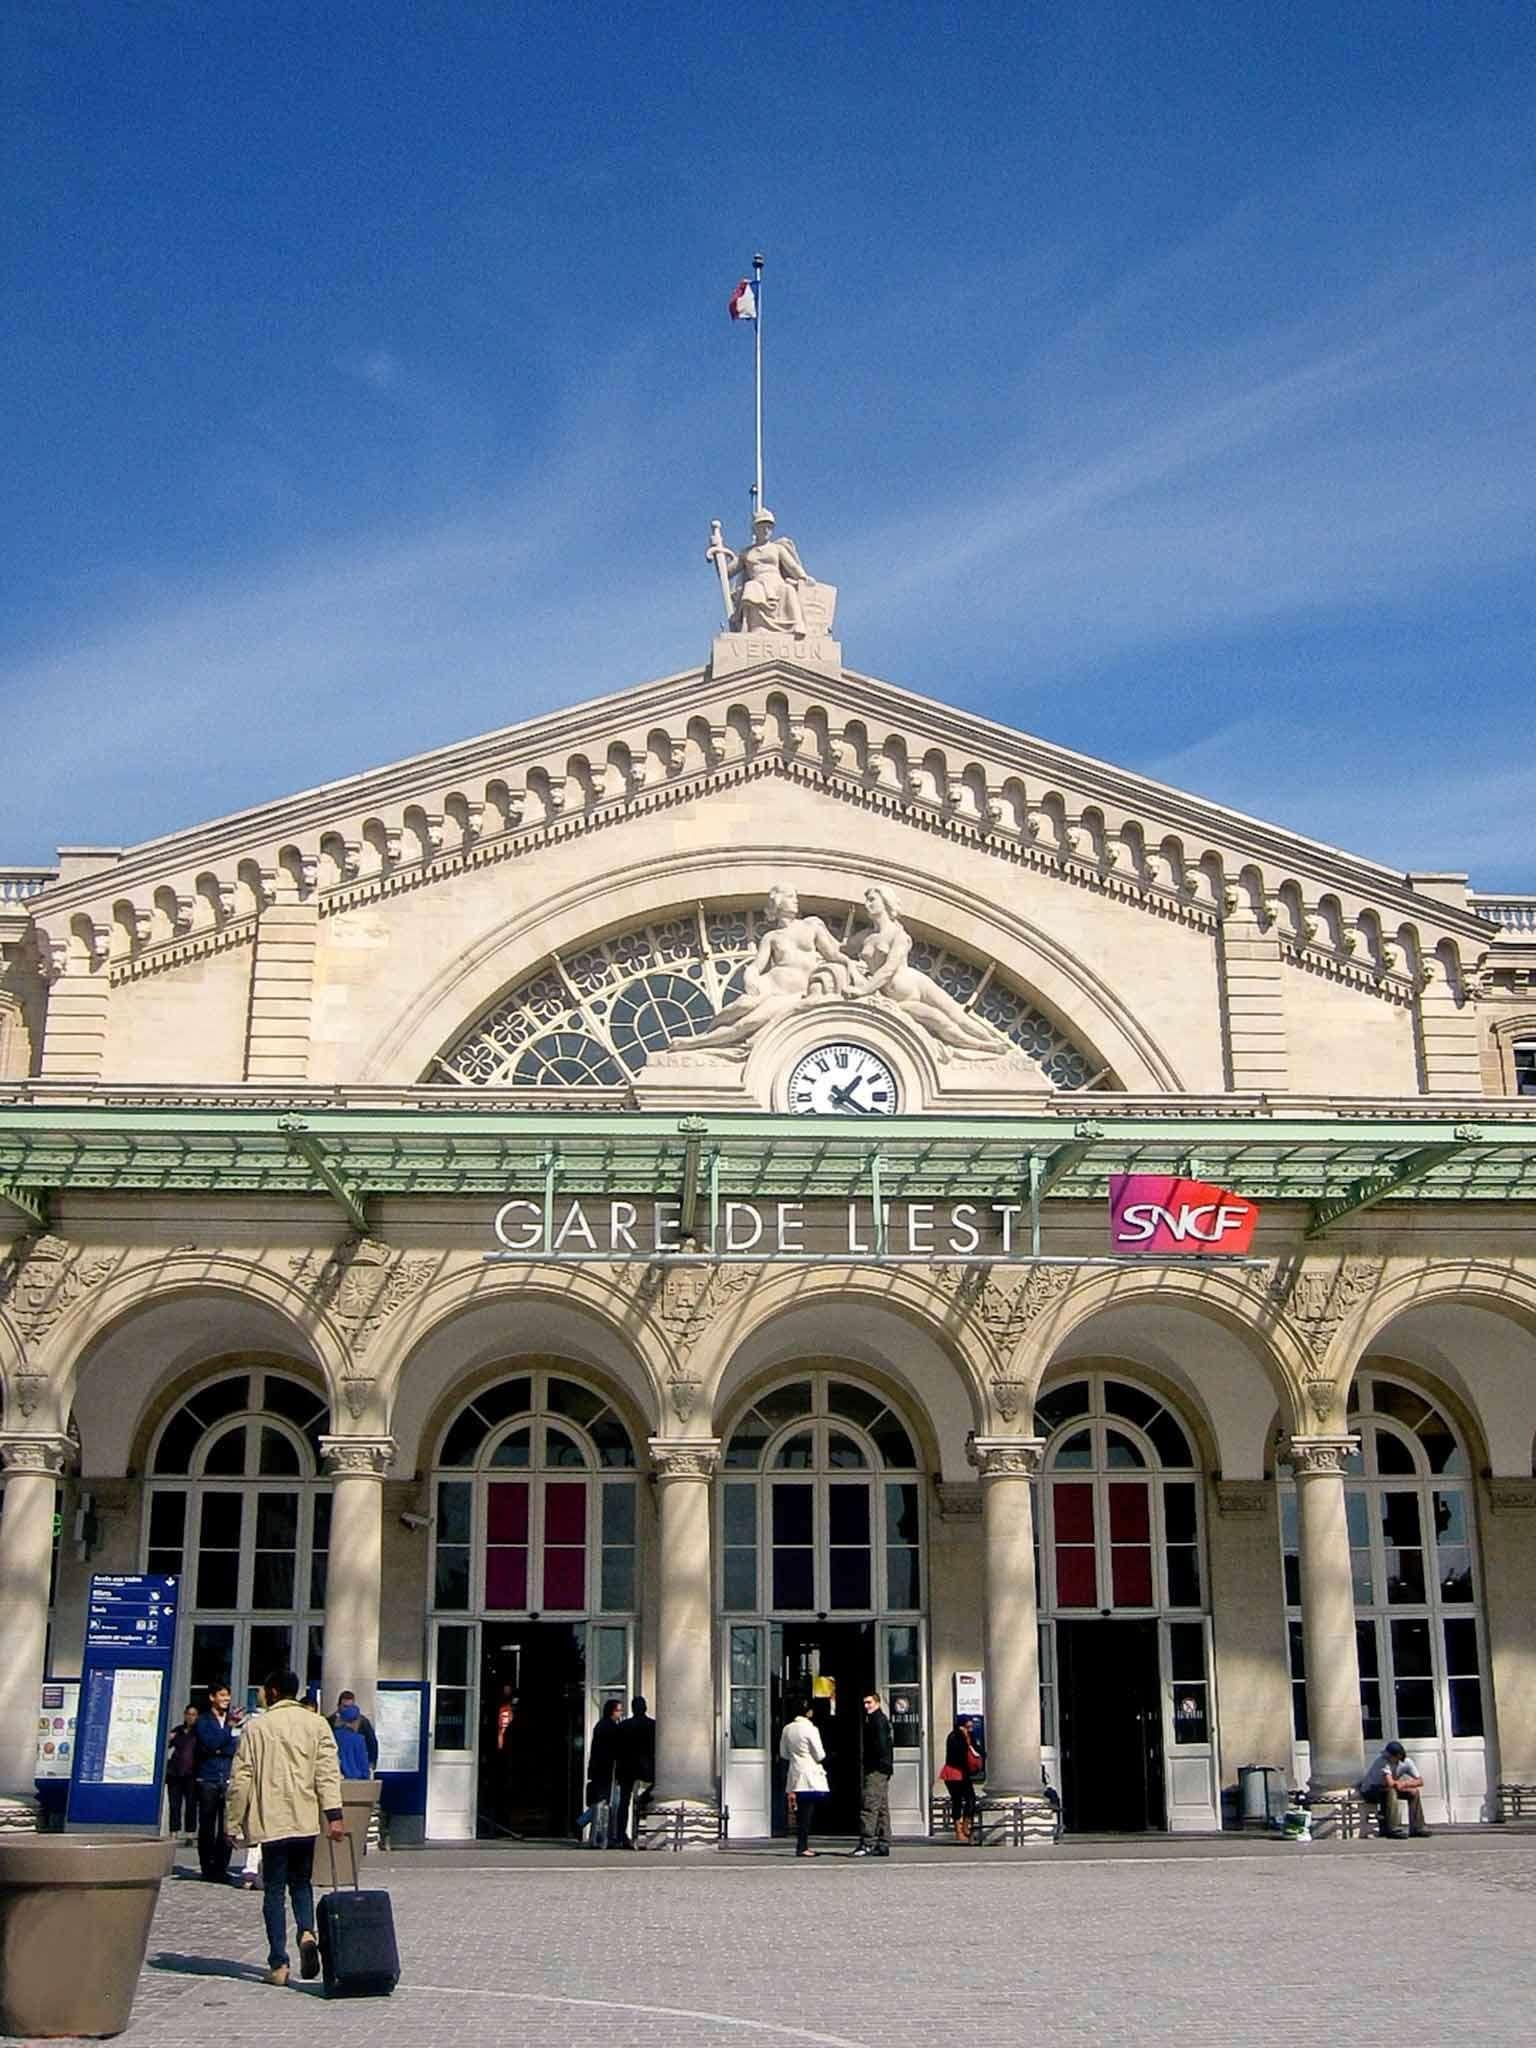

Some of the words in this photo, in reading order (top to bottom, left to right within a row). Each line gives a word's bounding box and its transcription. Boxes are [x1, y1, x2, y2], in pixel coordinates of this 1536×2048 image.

[730, 640, 823, 660] VERDUN
[494, 1200, 681, 1250] GARE
[726, 1202, 804, 1250] DE
[849, 1203, 1022, 1253] L'EST
[1118, 1204, 1249, 1241] SNCF
